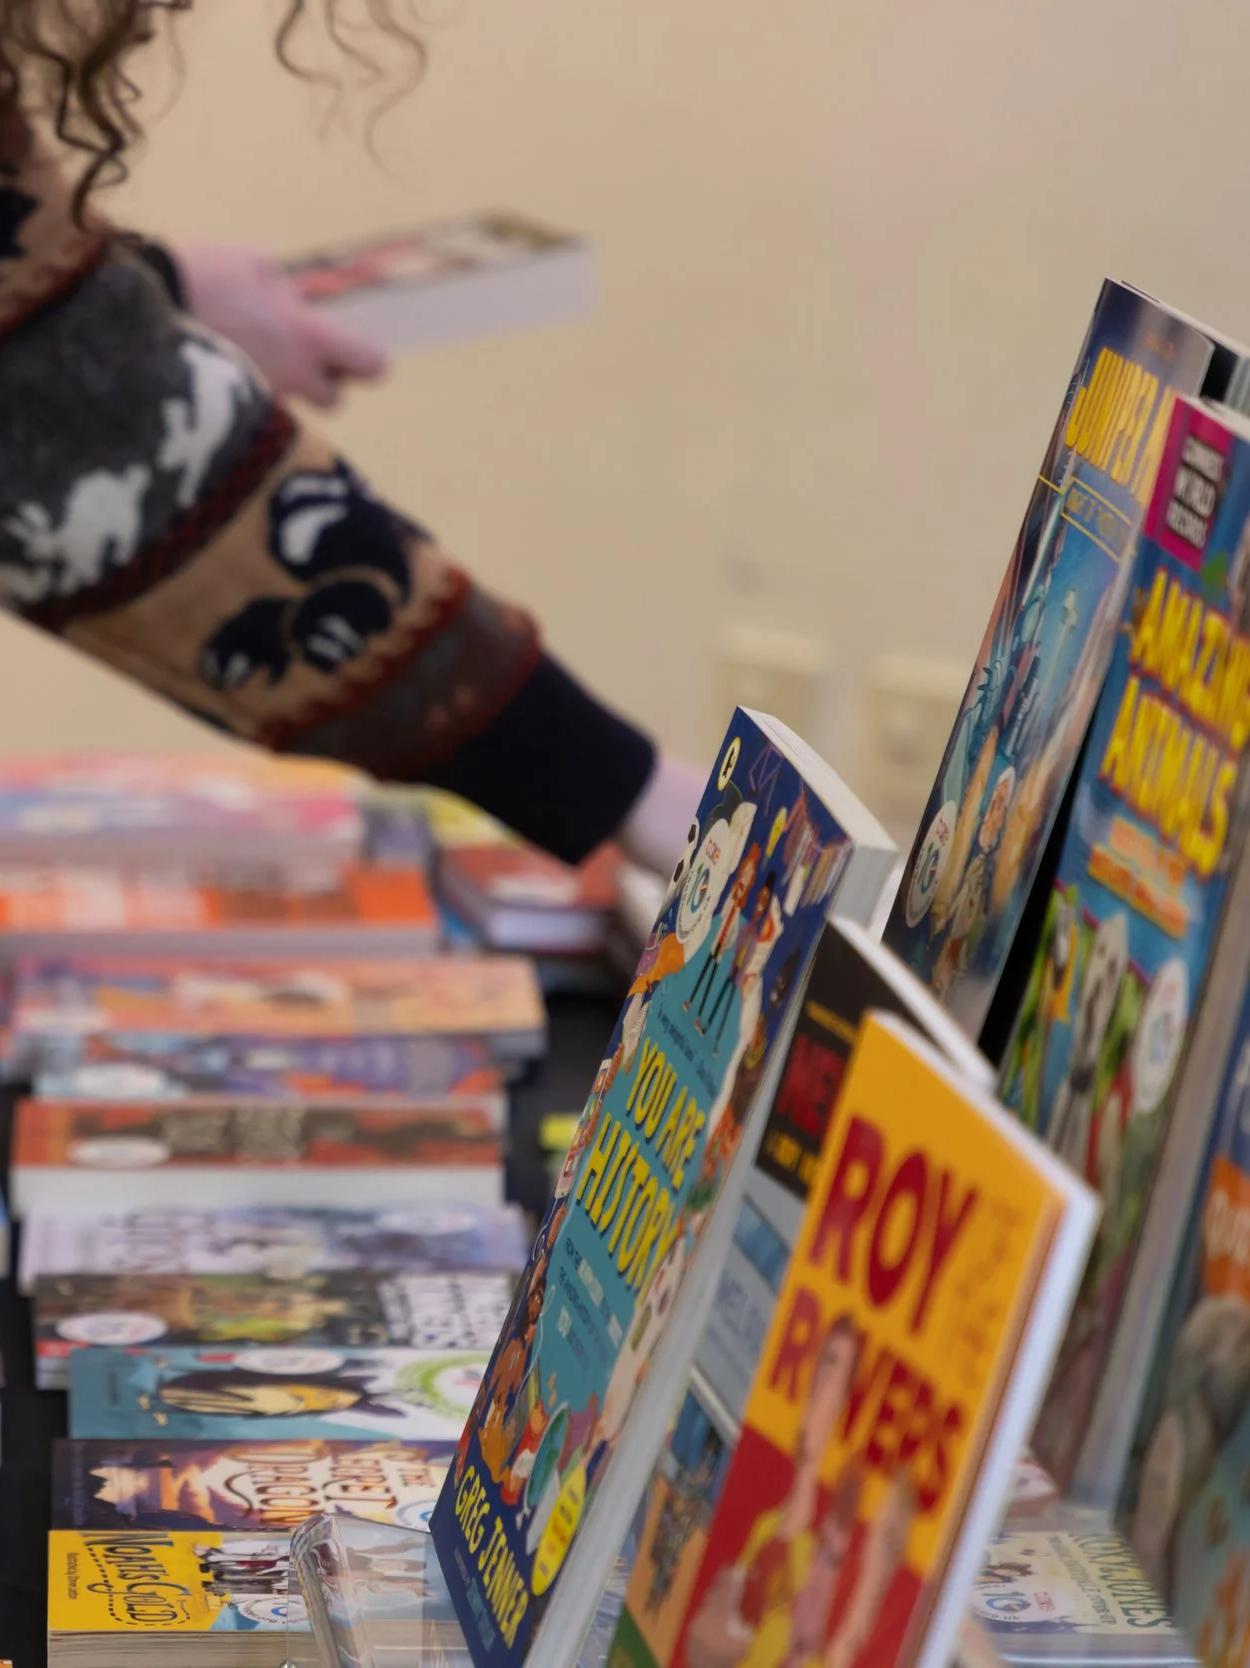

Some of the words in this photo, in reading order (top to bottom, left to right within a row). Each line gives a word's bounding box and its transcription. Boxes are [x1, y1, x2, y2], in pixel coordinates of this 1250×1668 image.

[1065, 346, 1159, 487] JUNIPER
[1100, 672, 1238, 882] ANIMALS
[686, 863, 711, 914] 10
[626, 1036, 678, 1140] YOU
[655, 1086, 706, 1190] ARE
[576, 1111, 680, 1307] HISTORY
[808, 1112, 980, 1340] ROY
[768, 1284, 967, 1518] RVERS
[224, 1441, 326, 1528] DRAGON
[397, 1468, 436, 1488] THE
[83, 1532, 174, 1580] NOAH'S
[87, 1582, 191, 1622] GOLD
[455, 1465, 490, 1554] GREG
[478, 1516, 529, 1649] JENNER
[982, 1591, 1032, 1612] 10
[1098, 1575, 1174, 1628] JONES
